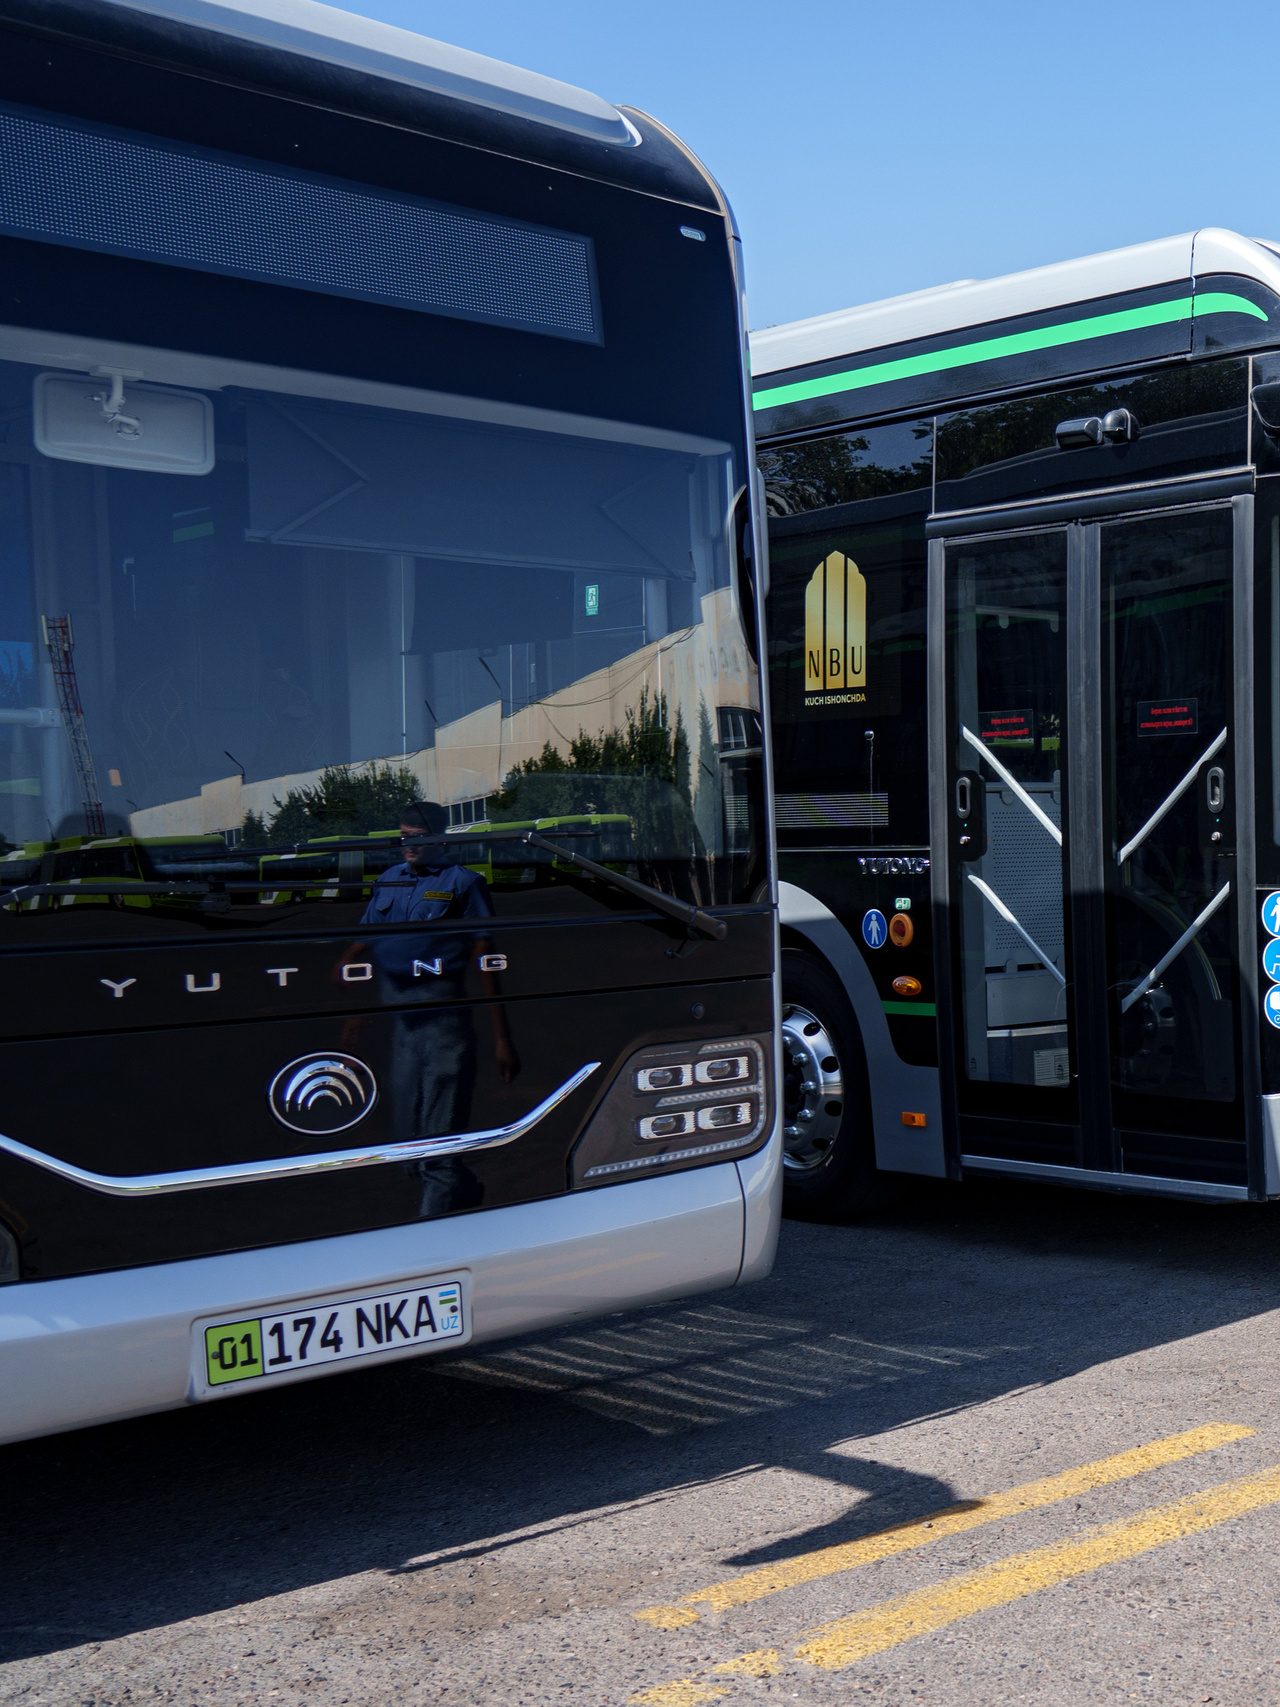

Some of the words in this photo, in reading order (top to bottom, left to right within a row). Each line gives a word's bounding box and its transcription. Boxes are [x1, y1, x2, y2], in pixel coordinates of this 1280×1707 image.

[808, 645, 863, 679] NBU
[804, 697, 824, 707] KUCH
[824, 693, 867, 705] ISHONCHDA
[857, 857, 931, 875] YUTONG
[100, 953, 508, 998] YUTONG
[218, 1332, 259, 1370] 01
[268, 1311, 344, 1367] 174
[355, 1294, 438, 1349] NKA
[440, 1315, 459, 1330] UZ
